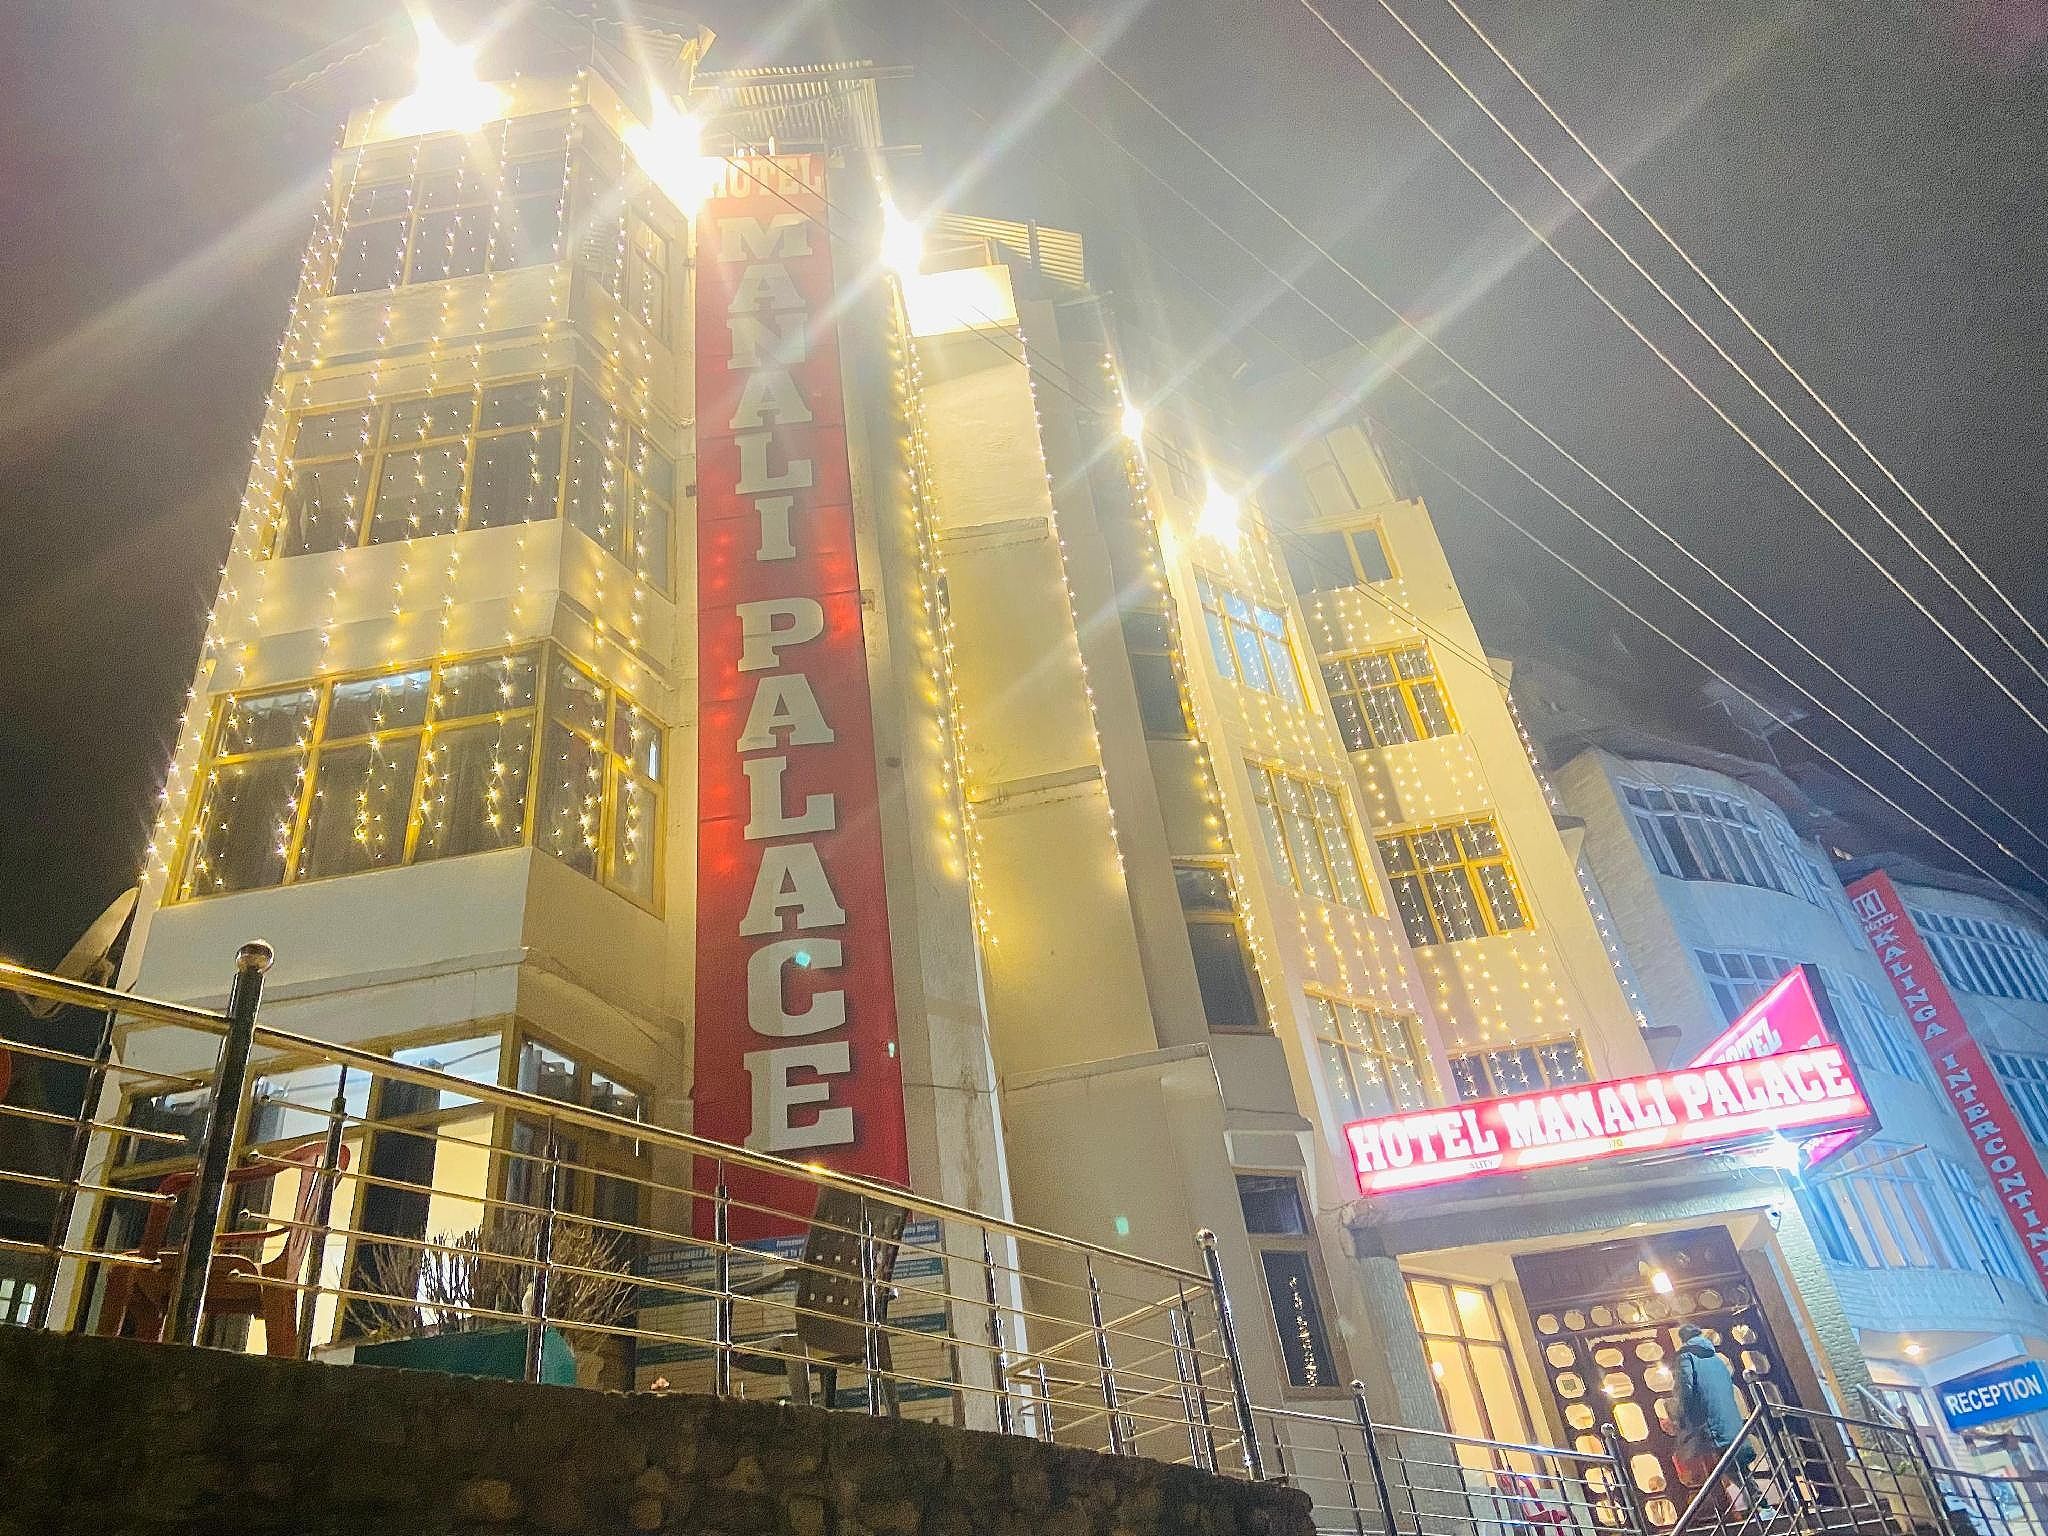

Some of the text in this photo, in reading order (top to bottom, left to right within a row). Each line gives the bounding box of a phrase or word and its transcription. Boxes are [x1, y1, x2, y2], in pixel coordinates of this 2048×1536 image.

[715, 213, 857, 1152] MANALI PALACE
[1717, 1016, 1783, 1060] OTEL
[1872, 926, 1949, 1041] KALINGA
[1349, 1049, 1856, 1173] HOTEL MANALI PALACE
[1944, 1374, 2043, 1416] RECEPTION
